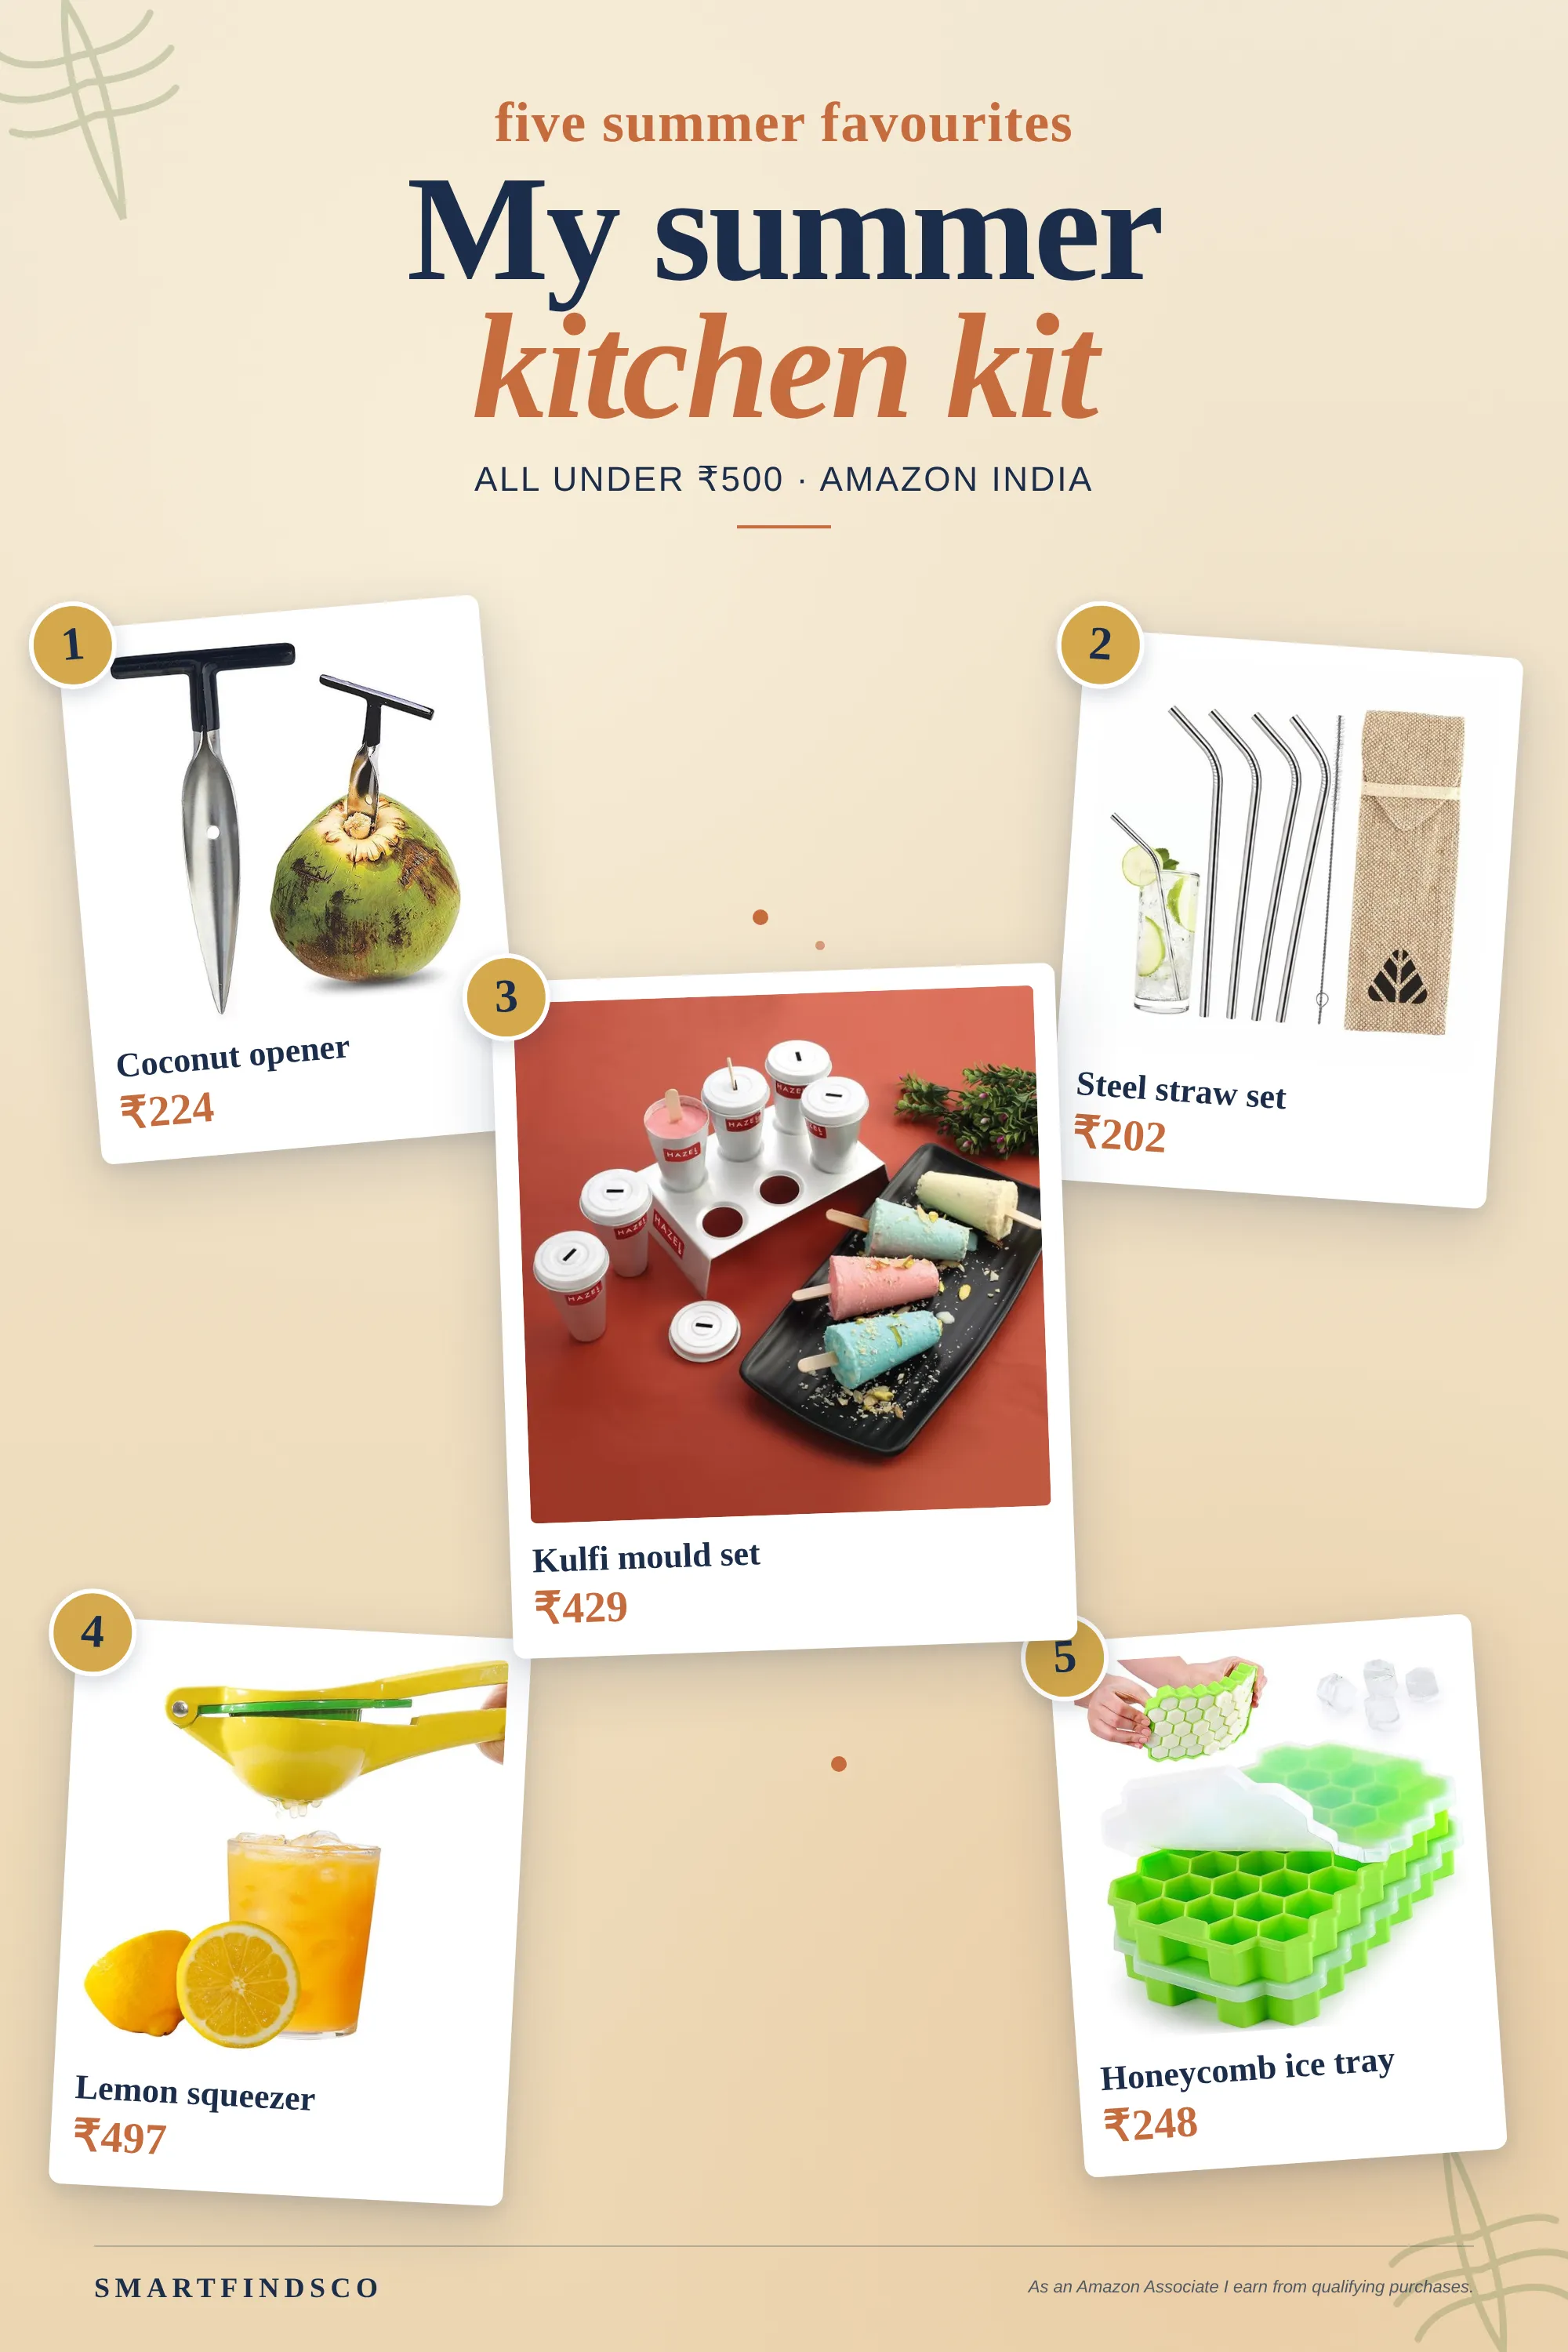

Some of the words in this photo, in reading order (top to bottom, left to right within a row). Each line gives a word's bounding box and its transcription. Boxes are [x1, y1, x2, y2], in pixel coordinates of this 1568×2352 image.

[495, 100, 584, 143] five
[603, 114, 804, 143] summer
[821, 100, 1072, 143] favourites
[408, 180, 620, 312] My
[657, 207, 1162, 281] summer
[474, 312, 907, 419] kitchen
[947, 312, 1103, 419] kit
[474, 466, 539, 492] ALL
[554, 466, 682, 492] UNDER
[699, 465, 782, 492] ₹500
[819, 466, 975, 492] AMAZON
[994, 466, 1092, 492] INDIA
[64, 627, 84, 661] 1
[1089, 627, 1111, 660] 2
[496, 980, 517, 1013] 3
[117, 1047, 241, 1077] Coconut
[249, 1040, 350, 1072] opener
[776, 1082, 805, 1094] HAZE
[1076, 1072, 1146, 1100] Steel
[1156, 1081, 1239, 1106] straw
[1246, 1089, 1287, 1109] set
[120, 1092, 214, 1129] ₹224
[1074, 1113, 1166, 1152] ₹202
[666, 1147, 699, 1158] HAZEL
[654, 1213, 682, 1254] HAZEL
[568, 1286, 601, 1301] HAZEL
[532, 1545, 609, 1573] Kulfi
[618, 1541, 712, 1570] mould
[720, 1544, 761, 1566] set
[535, 1589, 627, 1624] ₹429
[81, 1615, 104, 1648] 4
[1054, 1639, 1076, 1673] 5
[1100, 2055, 1276, 2092] Honeycomb
[1285, 2053, 1325, 2078] ice
[1334, 2053, 1395, 2079] tray
[74, 2075, 178, 2104] Lemon
[187, 2087, 315, 2114] squeezer
[74, 2117, 167, 2154] ₹497
[1103, 2107, 1197, 2142] ₹248
[95, 2278, 378, 2298] SMARTFINDSCO
[1028, 2280, 1048, 2293] As
[1053, 2282, 1073, 2293] an
[1076, 2280, 1140, 2293] Amazon
[1143, 2279, 1219, 2293] Associate
[1224, 2280, 1229, 2293] I
[1233, 2282, 1268, 2293] earn
[1272, 2279, 1307, 2293] from
[1312, 2279, 1385, 2296] qualifying
[1388, 2279, 1472, 2296] purchases.
